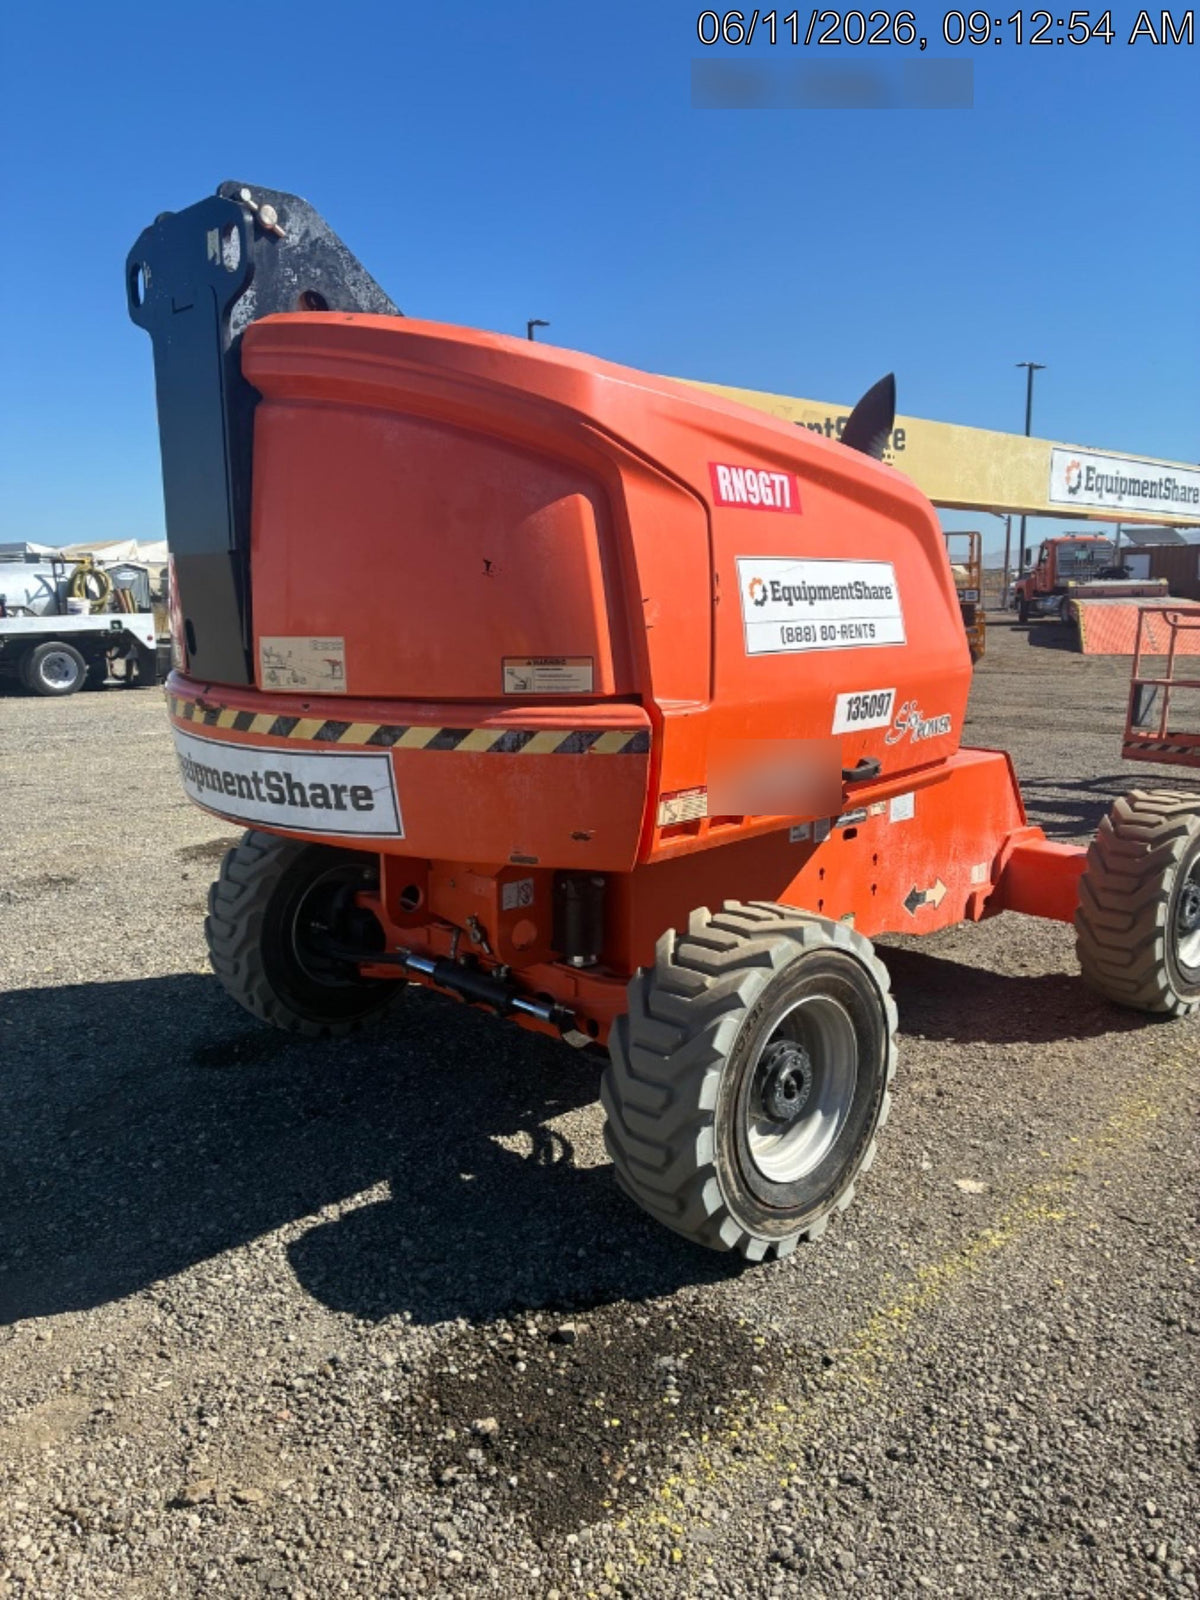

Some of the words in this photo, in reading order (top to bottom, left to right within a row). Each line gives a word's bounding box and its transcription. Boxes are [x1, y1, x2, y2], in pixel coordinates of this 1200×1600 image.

[716, 465, 791, 508] RN9G77
[1084, 465, 1200, 503] EquipmentShare
[769, 580, 893, 606] EquipmentShare
[780, 624, 817, 645] (888)
[820, 623, 876, 641] 80-RENTS
[846, 693, 892, 722] 135097
